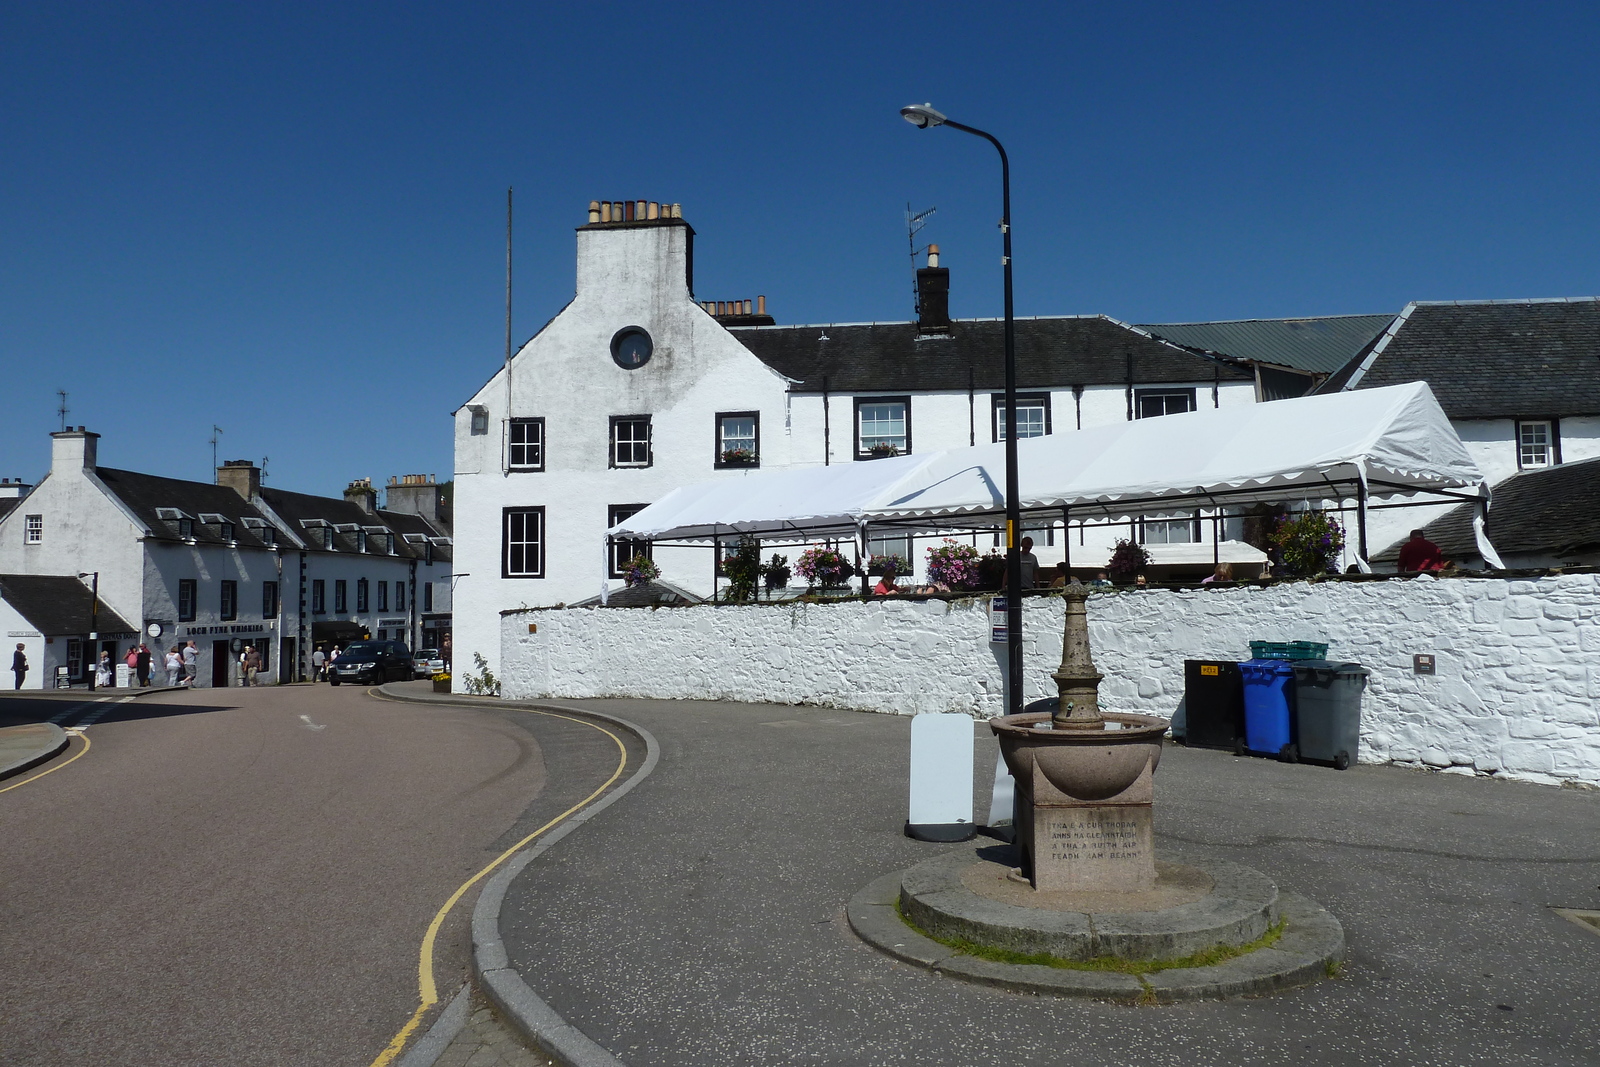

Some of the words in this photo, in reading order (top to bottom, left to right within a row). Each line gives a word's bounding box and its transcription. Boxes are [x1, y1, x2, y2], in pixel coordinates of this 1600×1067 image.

[187, 627, 207, 635] LOCH
[209, 626, 228, 634] FYNE
[231, 625, 264, 633] WHISKIES
